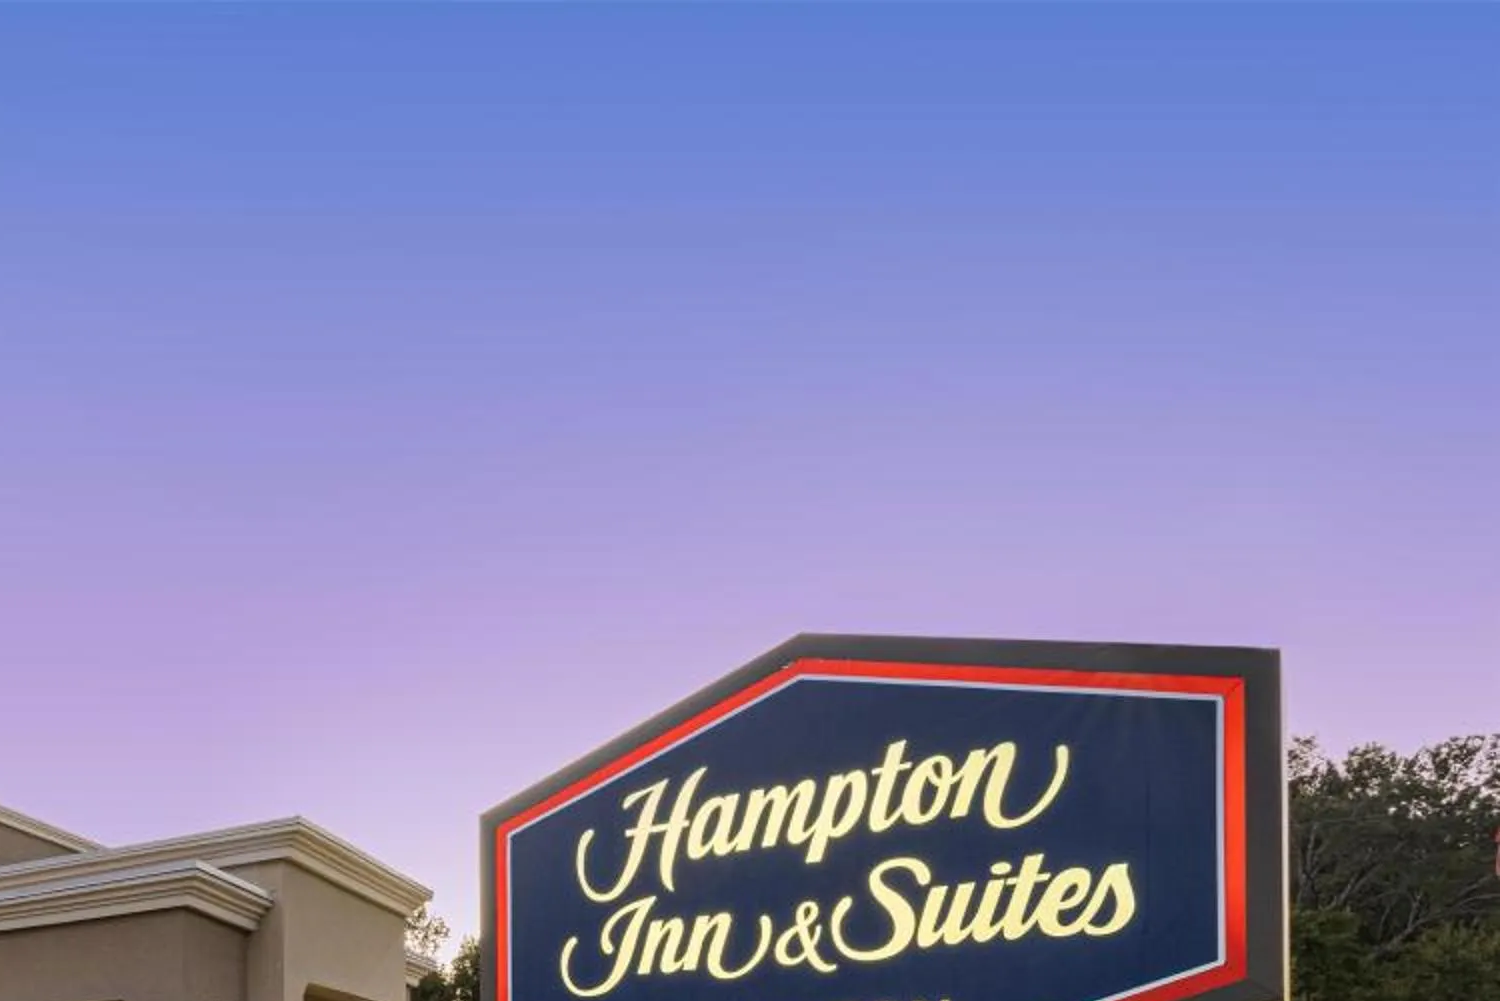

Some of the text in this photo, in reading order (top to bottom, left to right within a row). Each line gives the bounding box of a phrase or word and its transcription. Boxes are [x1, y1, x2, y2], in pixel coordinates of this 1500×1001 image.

[576, 739, 1069, 903] Hampton
[560, 895, 773, 998] Inn
[830, 852, 1136, 963] Suites
